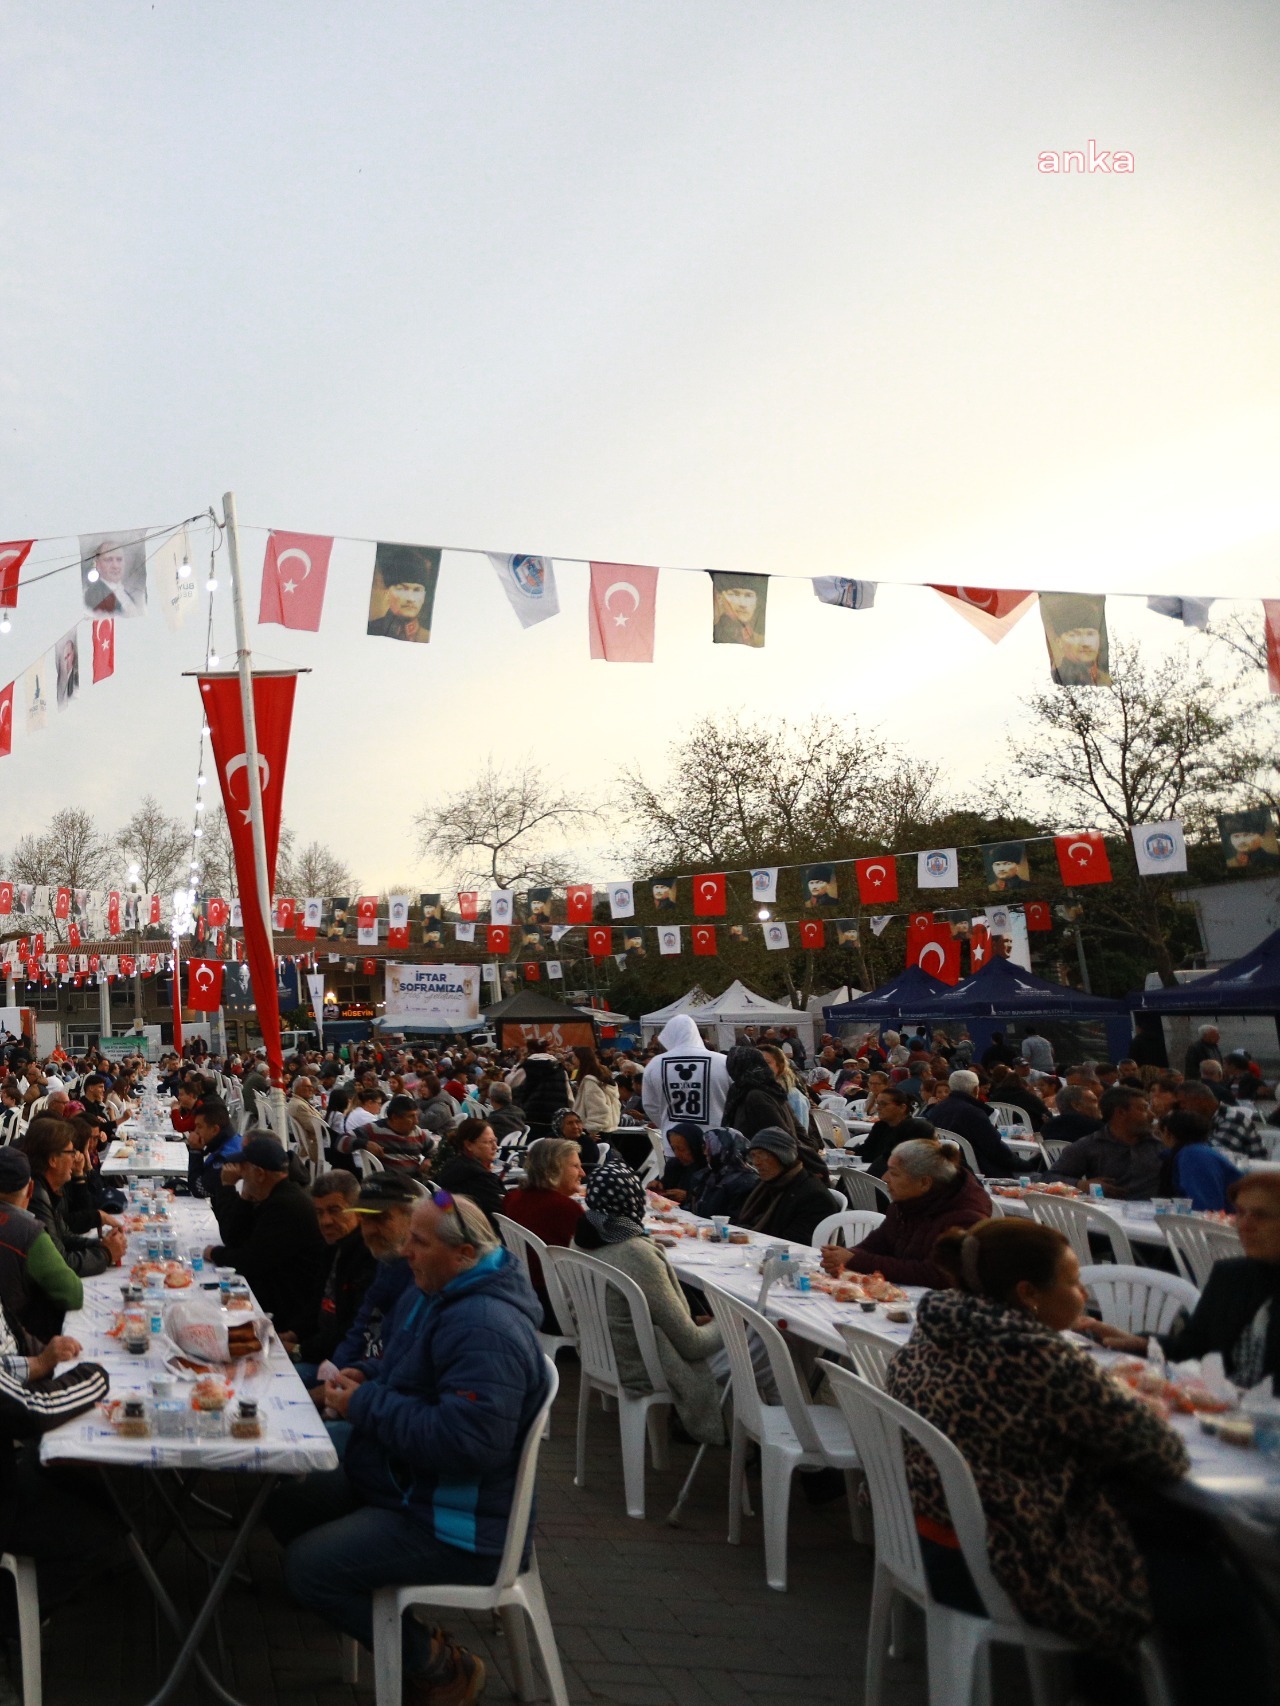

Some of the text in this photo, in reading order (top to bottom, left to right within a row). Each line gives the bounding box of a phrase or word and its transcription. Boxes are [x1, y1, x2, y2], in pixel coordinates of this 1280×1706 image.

[416, 970, 447, 982] İFTAR
[400, 983, 464, 993] SOFRAMIZA
[341, 1009, 374, 1017] HÜSEYİN
[671, 1090, 701, 1115] 28
